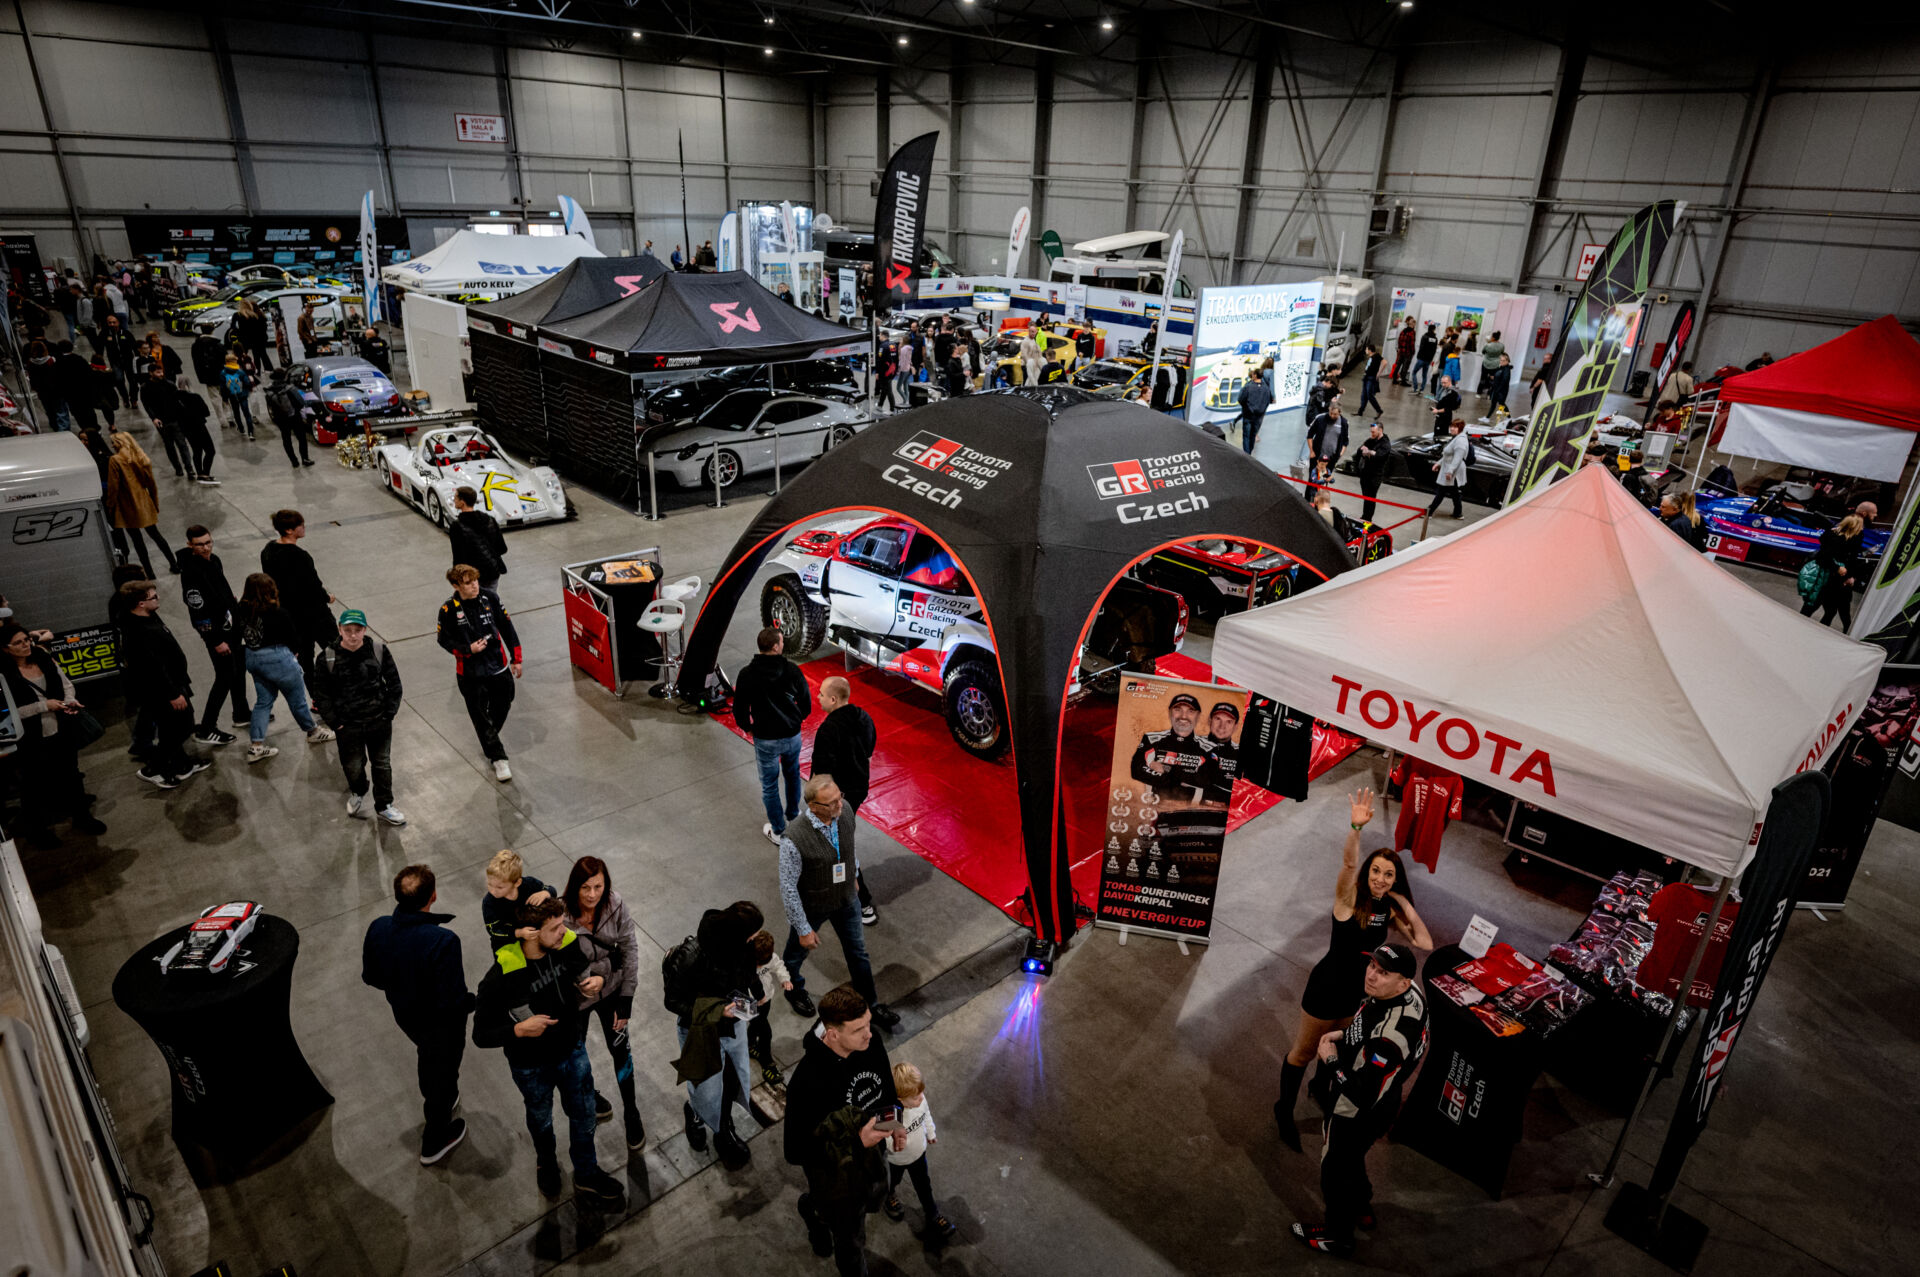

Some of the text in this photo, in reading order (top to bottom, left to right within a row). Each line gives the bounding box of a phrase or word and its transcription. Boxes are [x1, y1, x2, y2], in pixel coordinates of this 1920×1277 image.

[464, 281, 515, 289] AUTO KELLY
[1208, 292, 1288, 316] TRACKDAYS
[899, 441, 951, 471] GR
[961, 446, 1014, 471] TOYOTA
[1142, 450, 1202, 468] TOYOTA
[1519, 412, 1548, 492] MOTORSPORT
[939, 466, 988, 490] Racing
[948, 456, 999, 478] GAZOO
[1148, 461, 1201, 479] GAZOO
[882, 464, 963, 510] Czech
[1096, 472, 1149, 497] GR
[1152, 471, 1205, 490] Racing
[1116, 491, 1210, 525] Czech
[13, 507, 88, 545] 52
[897, 599, 927, 619] GR
[927, 604, 962, 617] GAZOO
[932, 595, 972, 611] TOYOTA
[908, 621, 945, 640] Czech
[926, 611, 958, 626] Racing
[1331, 674, 1557, 798] TOYOTA
[1102, 905, 1206, 929] #NEVERGIVEUP
[1447, 1051, 1459, 1081] TOYOTA
[1454, 1058, 1466, 1088] GAZOO
[1447, 1089, 1465, 1121] GR
[1468, 1079, 1486, 1119] Czech
